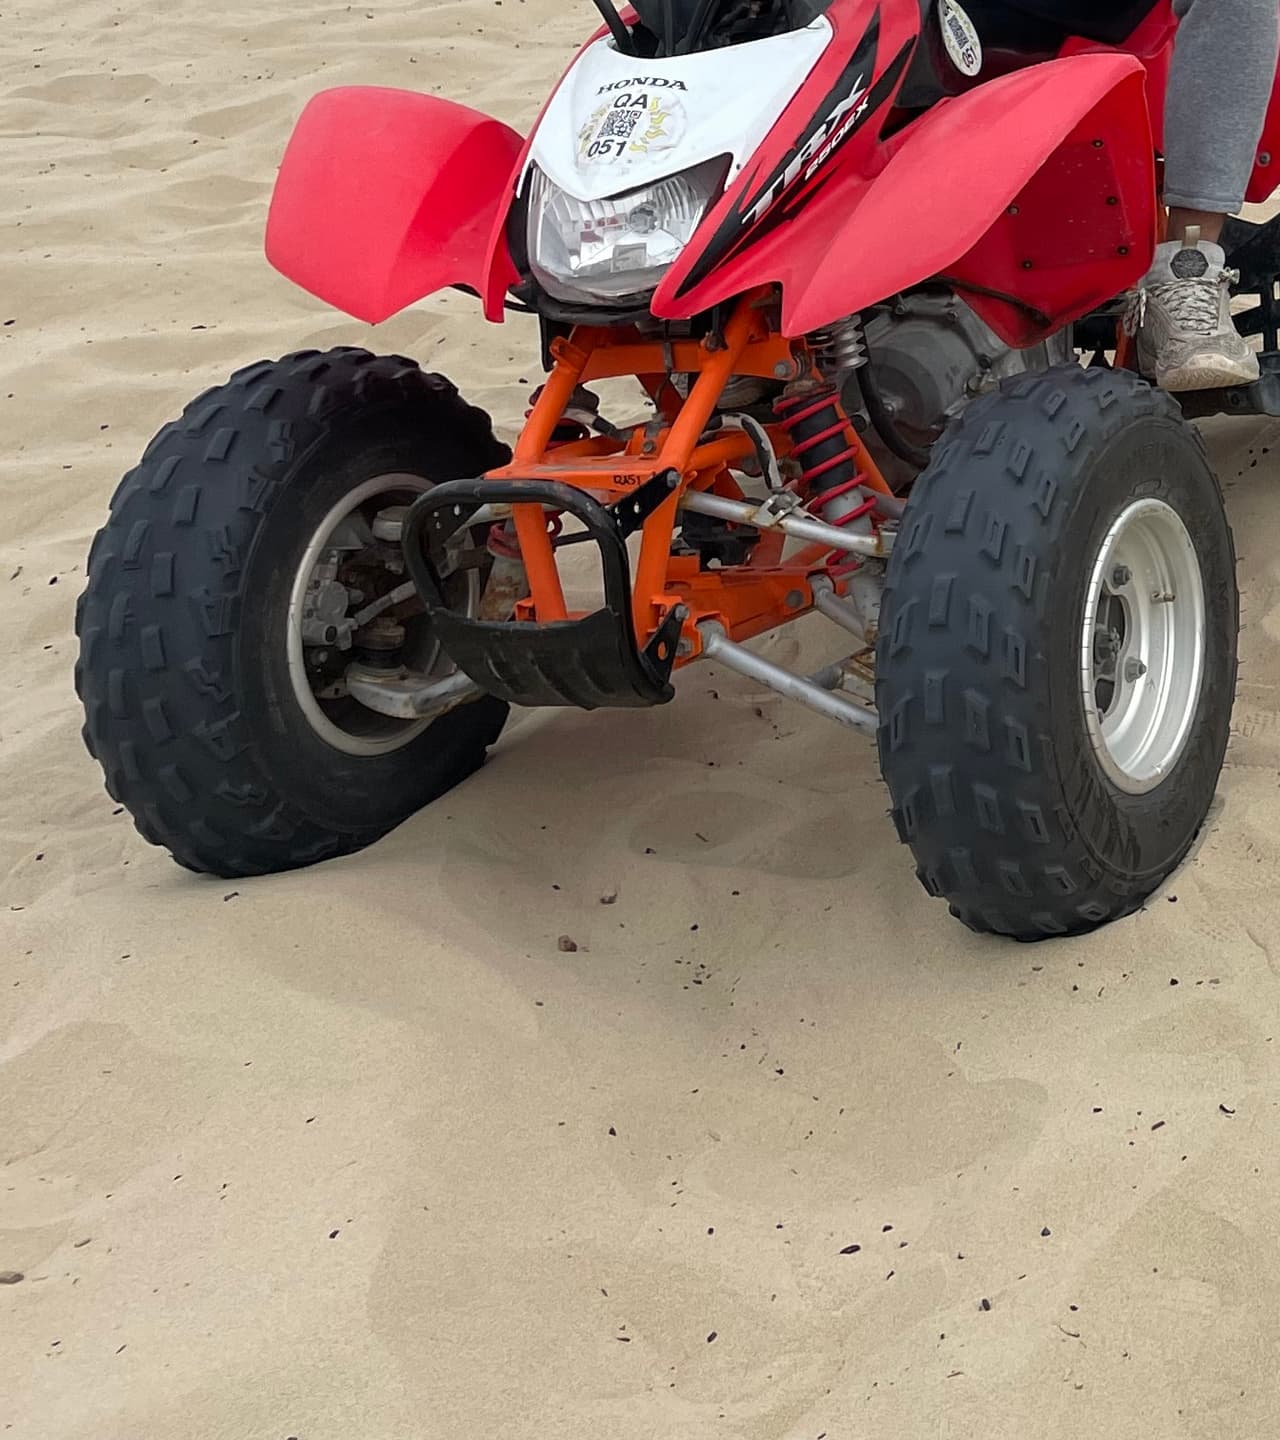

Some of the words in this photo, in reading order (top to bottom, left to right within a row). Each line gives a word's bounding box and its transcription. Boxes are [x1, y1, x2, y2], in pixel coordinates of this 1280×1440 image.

[595, 76, 688, 96] HONDA
[613, 93, 648, 109] QA
[587, 139, 627, 157] 051
[805, 96, 870, 180] 250EX
[742, 73, 866, 225] TRX
